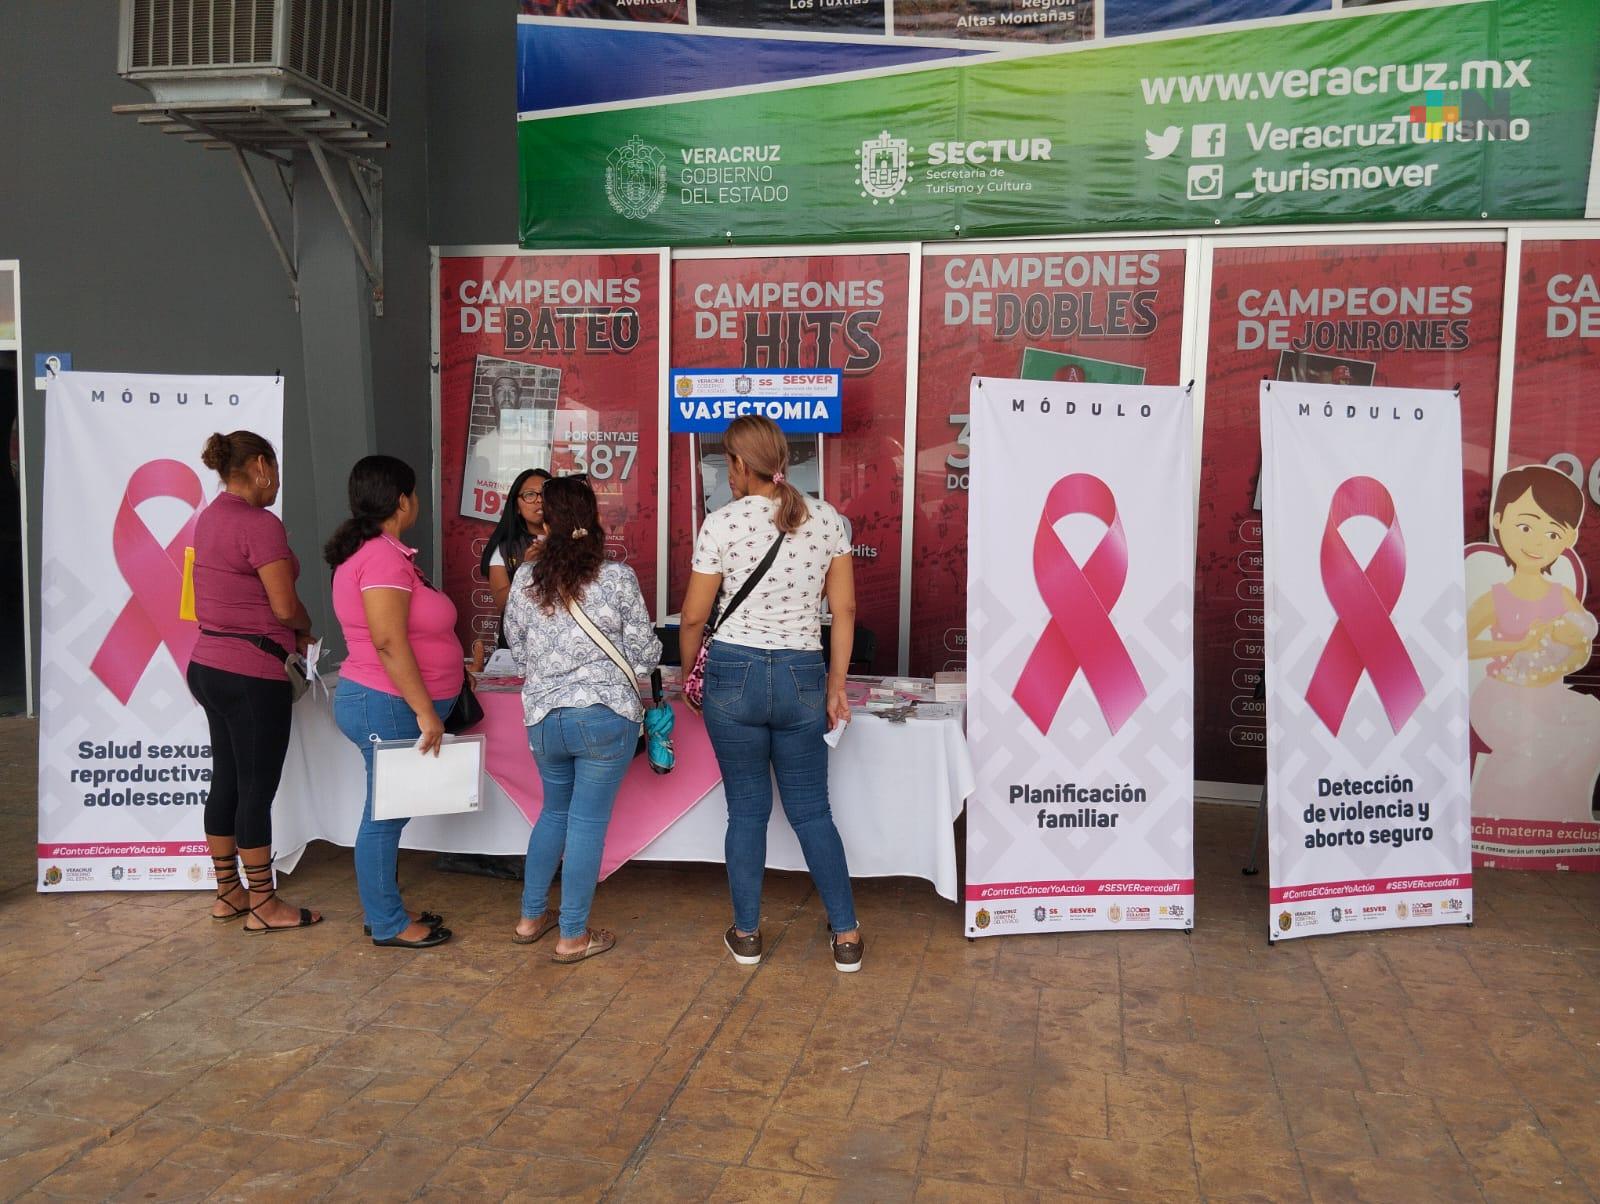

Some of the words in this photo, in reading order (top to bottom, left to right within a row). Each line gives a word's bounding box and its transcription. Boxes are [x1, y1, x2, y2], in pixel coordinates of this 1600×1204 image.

[790, 0, 814, 10] Los
[956, 15, 996, 28] Altas
[999, 10, 1076, 25] Montañas
[1140, 59, 1532, 105] www.veracruz.mx
[1245, 115, 1531, 151] VeracruzTurismo
[680, 144, 782, 165] VERACRUZ
[927, 138, 1053, 166] SECTUR
[680, 164, 773, 185] GOBIERNO
[989, 167, 1005, 178] de
[1234, 162, 1439, 200] _turismover
[680, 187, 714, 205] DEL
[719, 185, 789, 204] ESTADO
[925, 182, 974, 194] Turismo
[976, 184, 984, 195] y
[987, 181, 1033, 192] Cultura
[943, 254, 1161, 289] CAMPEONES
[458, 278, 641, 305] CAMPEONES
[694, 279, 885, 309] CAMPEONES
[1236, 285, 1473, 318] CAMPEONES
[943, 292, 993, 326] DE
[994, 290, 1159, 337] DOBLES
[459, 306, 502, 333] DE
[503, 306, 641, 352] BATEO
[1236, 319, 1291, 350] DE
[1292, 319, 1470, 350] JONRONES
[694, 310, 738, 339] DE
[742, 309, 883, 372] HITS
[783, 376, 833, 385] SESVER
[91, 387, 240, 407] MÓDULO
[1012, 397, 1152, 418] MÓDULO
[679, 400, 830, 420] VASECTOMIA
[1298, 401, 1425, 421] MÓDULO
[564, 431, 639, 442] PORCENTAJE
[851, 544, 878, 558] Hits
[1241, 702, 1265, 712] 2001
[1240, 731, 1264, 741] 2010
[78, 740, 142, 760] Salud
[70, 764, 213, 788] reproductiva
[1317, 774, 1414, 797] Detección
[1009, 783, 1147, 804] Planificación
[1036, 808, 1119, 829] familiar
[1303, 803, 1326, 824] de
[1329, 799, 1414, 822] violencia
[1418, 802, 1430, 822] y
[1304, 828, 1365, 849] aborto
[1369, 826, 1434, 848] seguro
[1497, 826, 1553, 838] materna
[1362, 905, 1387, 913] SESVER
